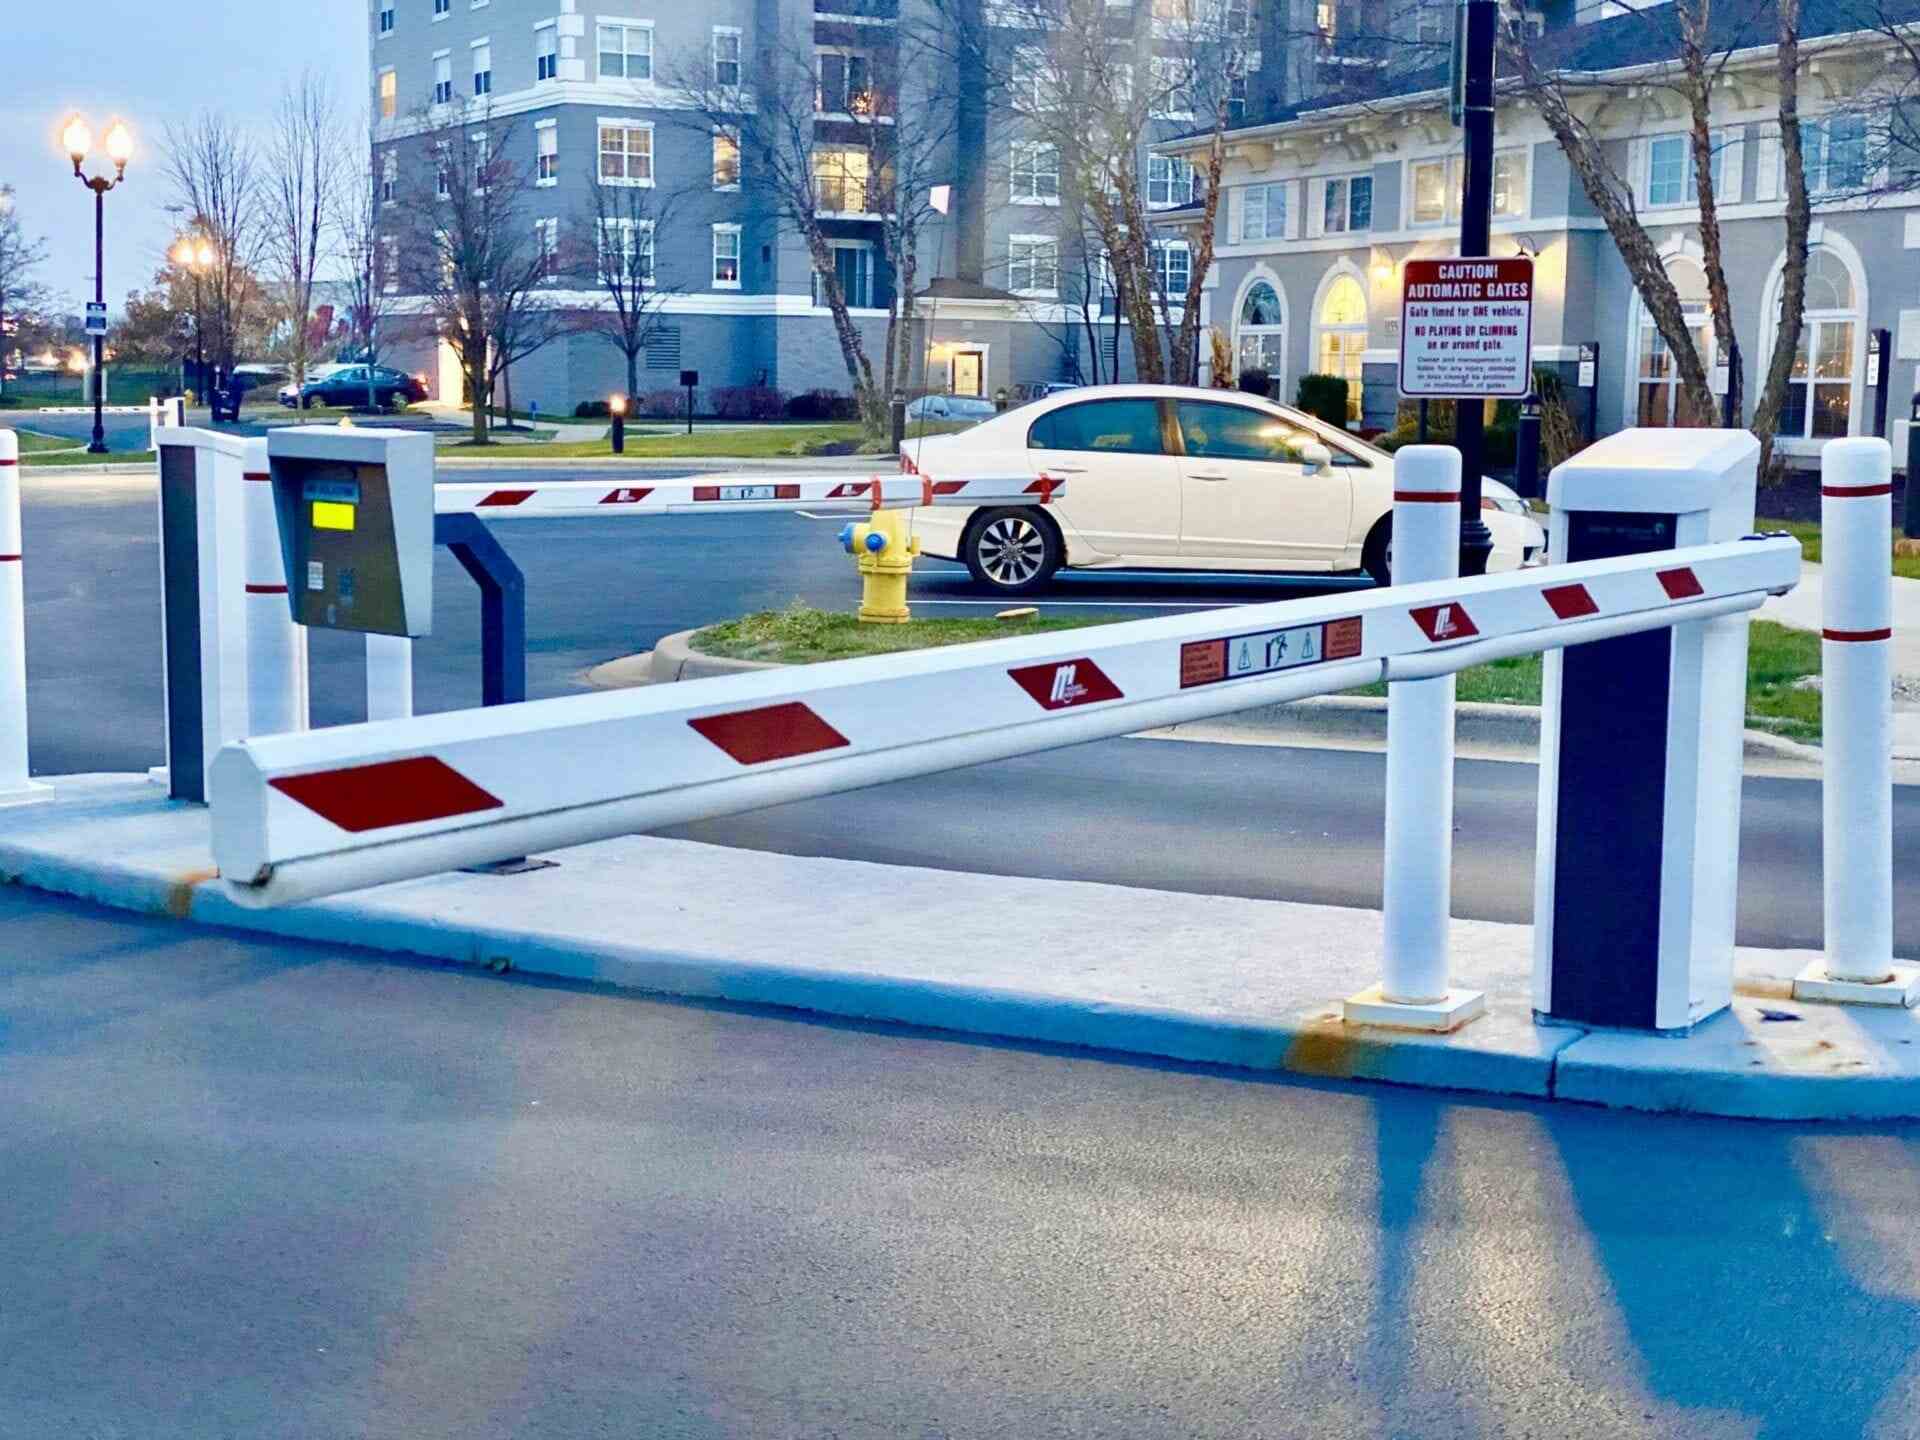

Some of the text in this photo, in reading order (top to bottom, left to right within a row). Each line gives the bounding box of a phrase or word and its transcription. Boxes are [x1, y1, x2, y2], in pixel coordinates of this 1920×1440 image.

[1438, 264, 1498, 279] CAUTION!
[1408, 283, 1528, 298] AUTOMATIC GATES
[1410, 305, 1524, 317] Gate timed for ONE vehicle.
[1415, 325, 1518, 336] NO PLAYING OR CLIMBING
[1427, 339, 1503, 351] on or around gate.
